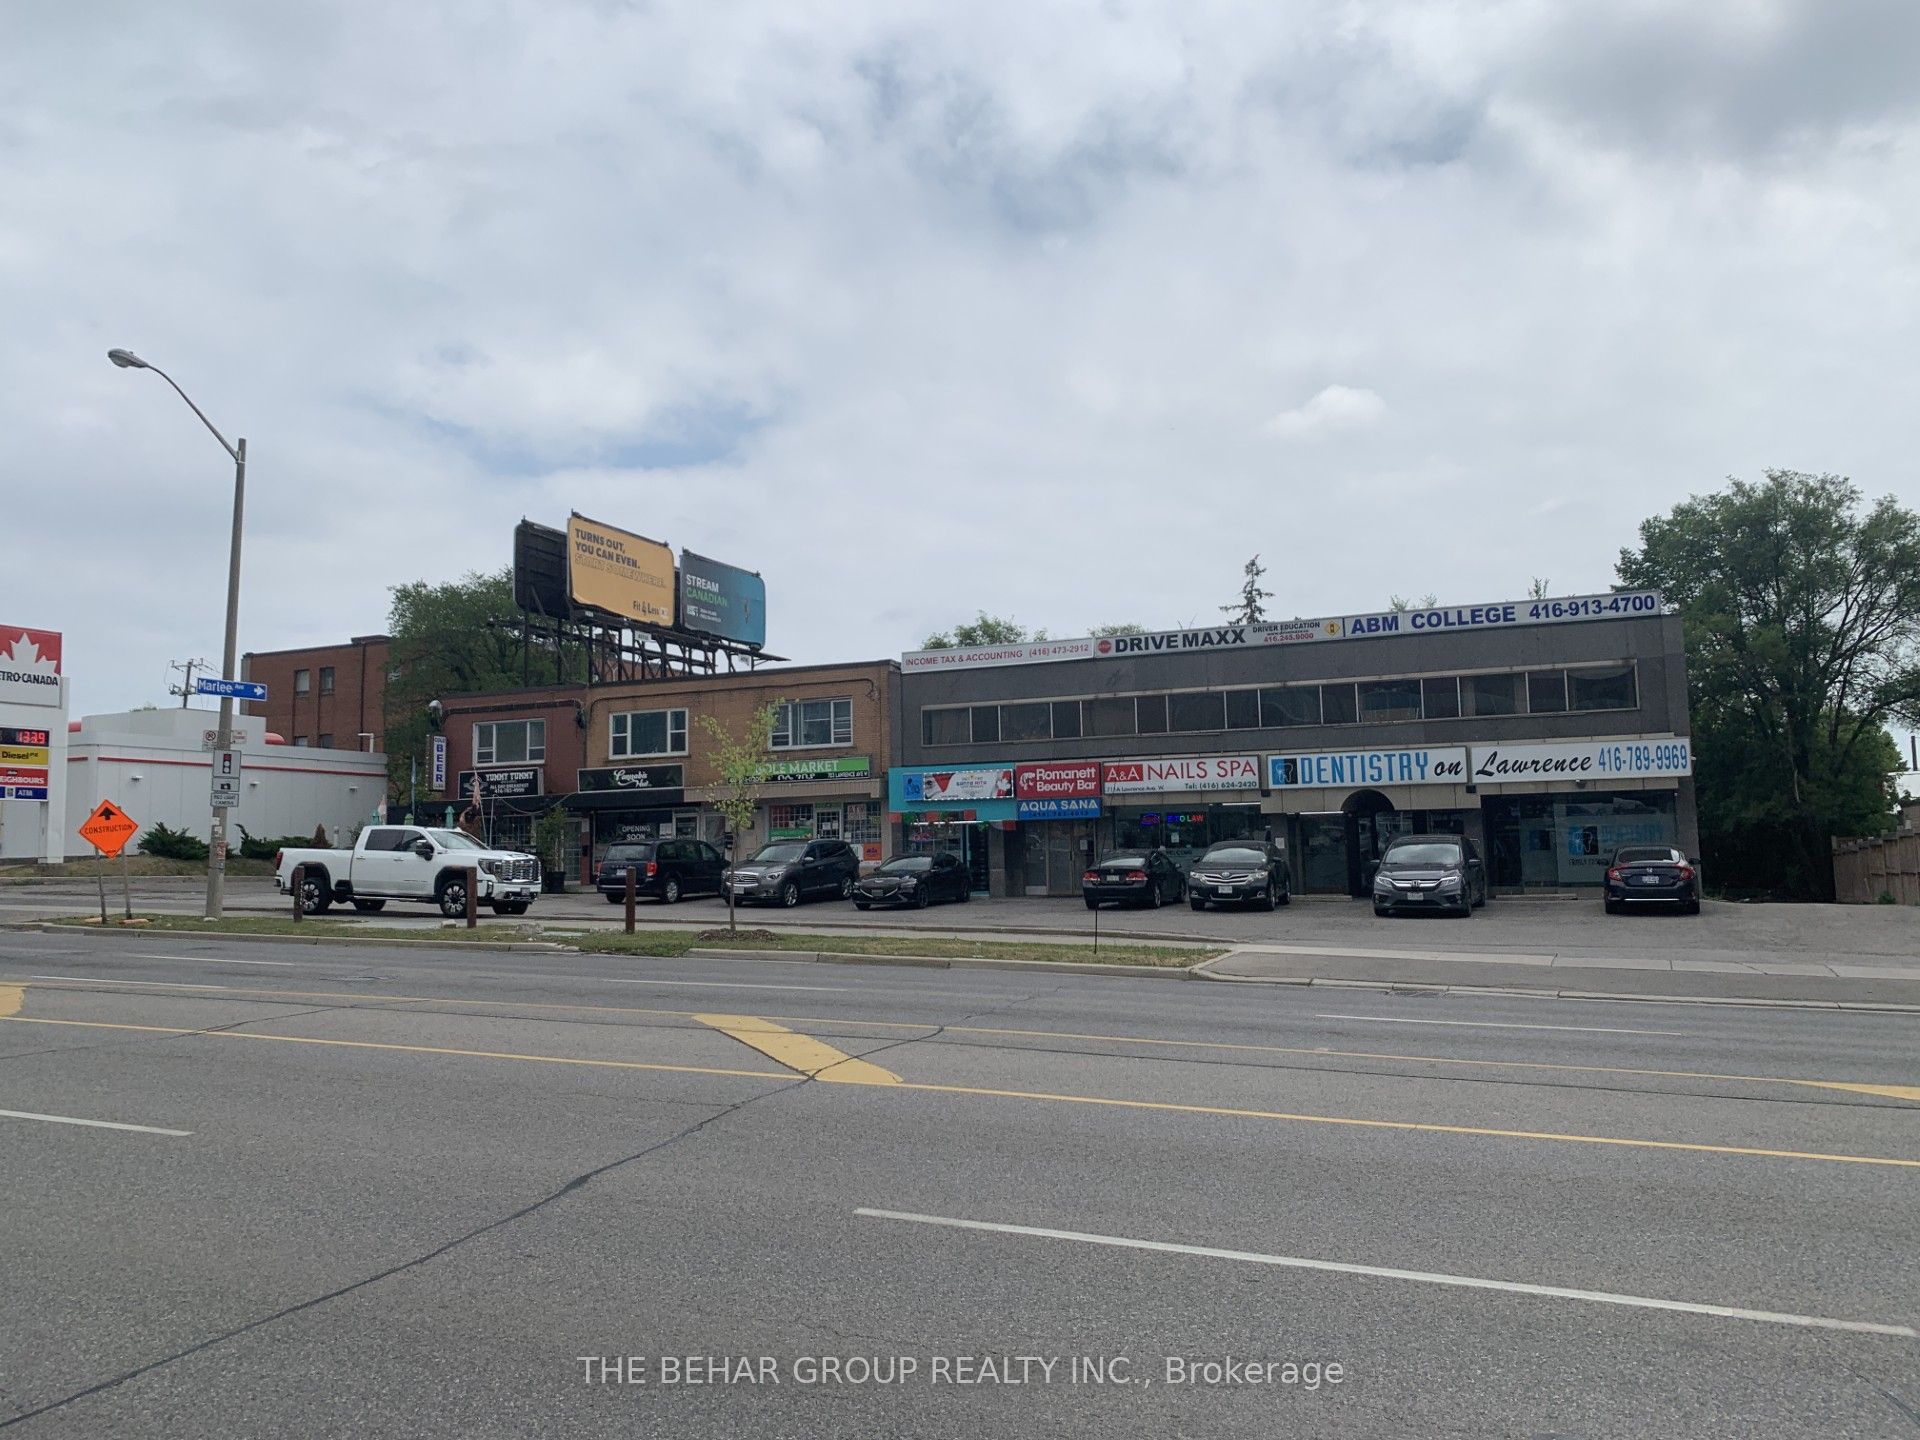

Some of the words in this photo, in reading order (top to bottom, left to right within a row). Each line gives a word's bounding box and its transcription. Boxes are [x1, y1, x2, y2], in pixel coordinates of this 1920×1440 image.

[575, 528, 605, 546] TURNS
[606, 538, 626, 553] OUT,
[575, 541, 594, 554] YOU
[596, 547, 614, 562] CAN
[616, 554, 640, 569] EVEN.
[686, 574, 719, 592] STREAM
[1350, 616, 1399, 635] ABM
[1411, 606, 1516, 630] COLLEGE
[1529, 595, 1656, 620] 416-913-4700
[1252, 625, 1278, 633] DRIVER
[1280, 621, 1320, 631] EDUCATION
[905, 657, 938, 666] INCOME
[941, 655, 955, 664] TAX
[958, 655, 964, 663] &
[966, 650, 1023, 662] ACCOUNTING
[198, 680, 233, 693] Marlee
[2, 750, 29, 760] Diesel
[436, 744, 444, 782] BEER
[789, 760, 839, 774] MARKET
[1300, 751, 1429, 785] DENTISTRY
[1434, 760, 1465, 777] on
[1475, 750, 1592, 778] Lawrence
[1598, 743, 1689, 773] 416-789-9969
[486, 772, 509, 782] YUMMY
[510, 771, 534, 780] TUMMY
[1036, 766, 1096, 781] Romanett
[1106, 766, 1141, 782] A&A
[1147, 760, 1208, 780] NAILS
[1217, 759, 1257, 779] SPA
[1037, 781, 1074, 793] Beauty
[1077, 780, 1097, 790] Bar
[1200, 782, 1219, 790] (416)
[1020, 801, 1057, 812] AQUA
[1060, 799, 1098, 810] SANA
[84, 824, 133, 834] CONSTRUCTION
[622, 824, 651, 832] OPENING
